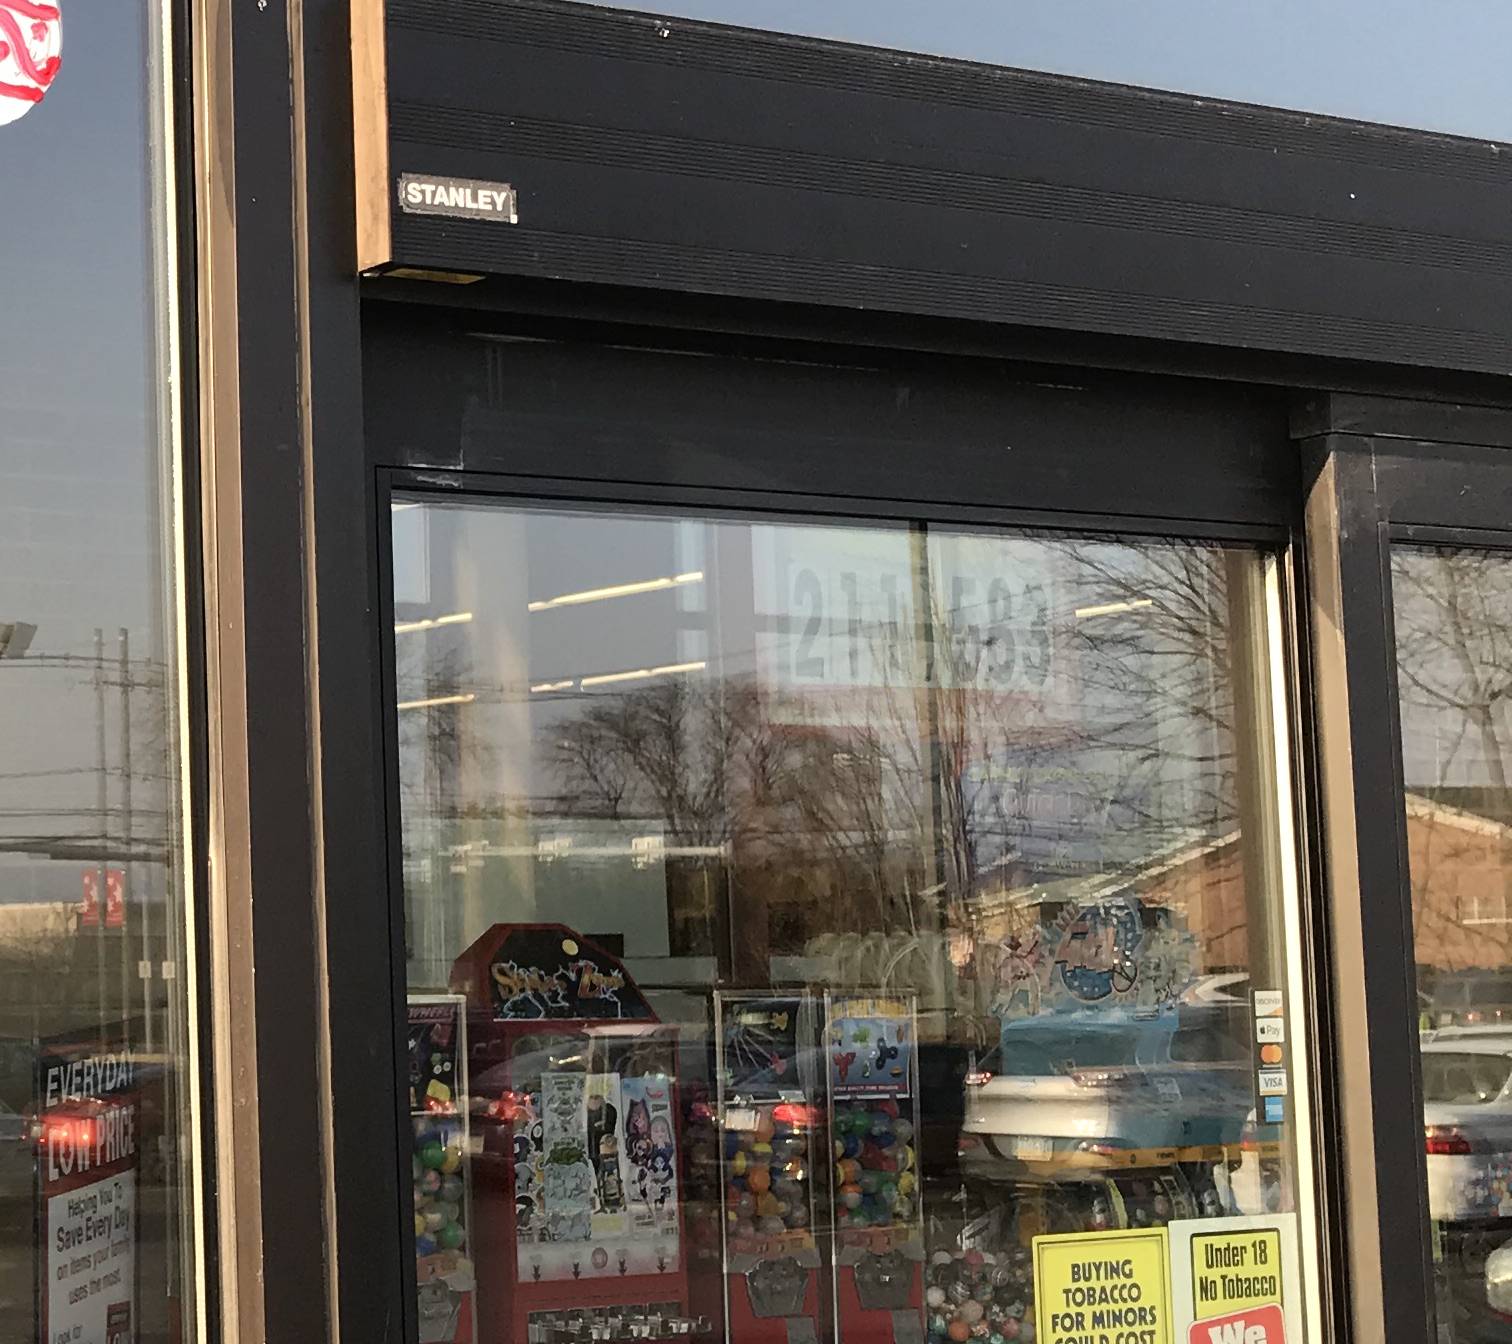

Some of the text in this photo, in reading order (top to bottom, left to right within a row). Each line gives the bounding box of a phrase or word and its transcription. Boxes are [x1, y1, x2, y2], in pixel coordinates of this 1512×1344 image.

[406, 182, 508, 212] STANLEY
[1266, 1025, 1281, 1037] Pay
[46, 1048, 136, 1107] EVERYDAY
[1263, 1077, 1284, 1088] VISA
[48, 1104, 136, 1182] LOW PRICE
[56, 1205, 131, 1253] Save Every Day
[1204, 1239, 1268, 1269] Under 18
[1070, 1259, 1134, 1283] BUYING
[1062, 1282, 1142, 1308] TOBACCO
[1198, 1274, 1277, 1302] No Tobacco
[1051, 1305, 1157, 1334] FOR MINORS
